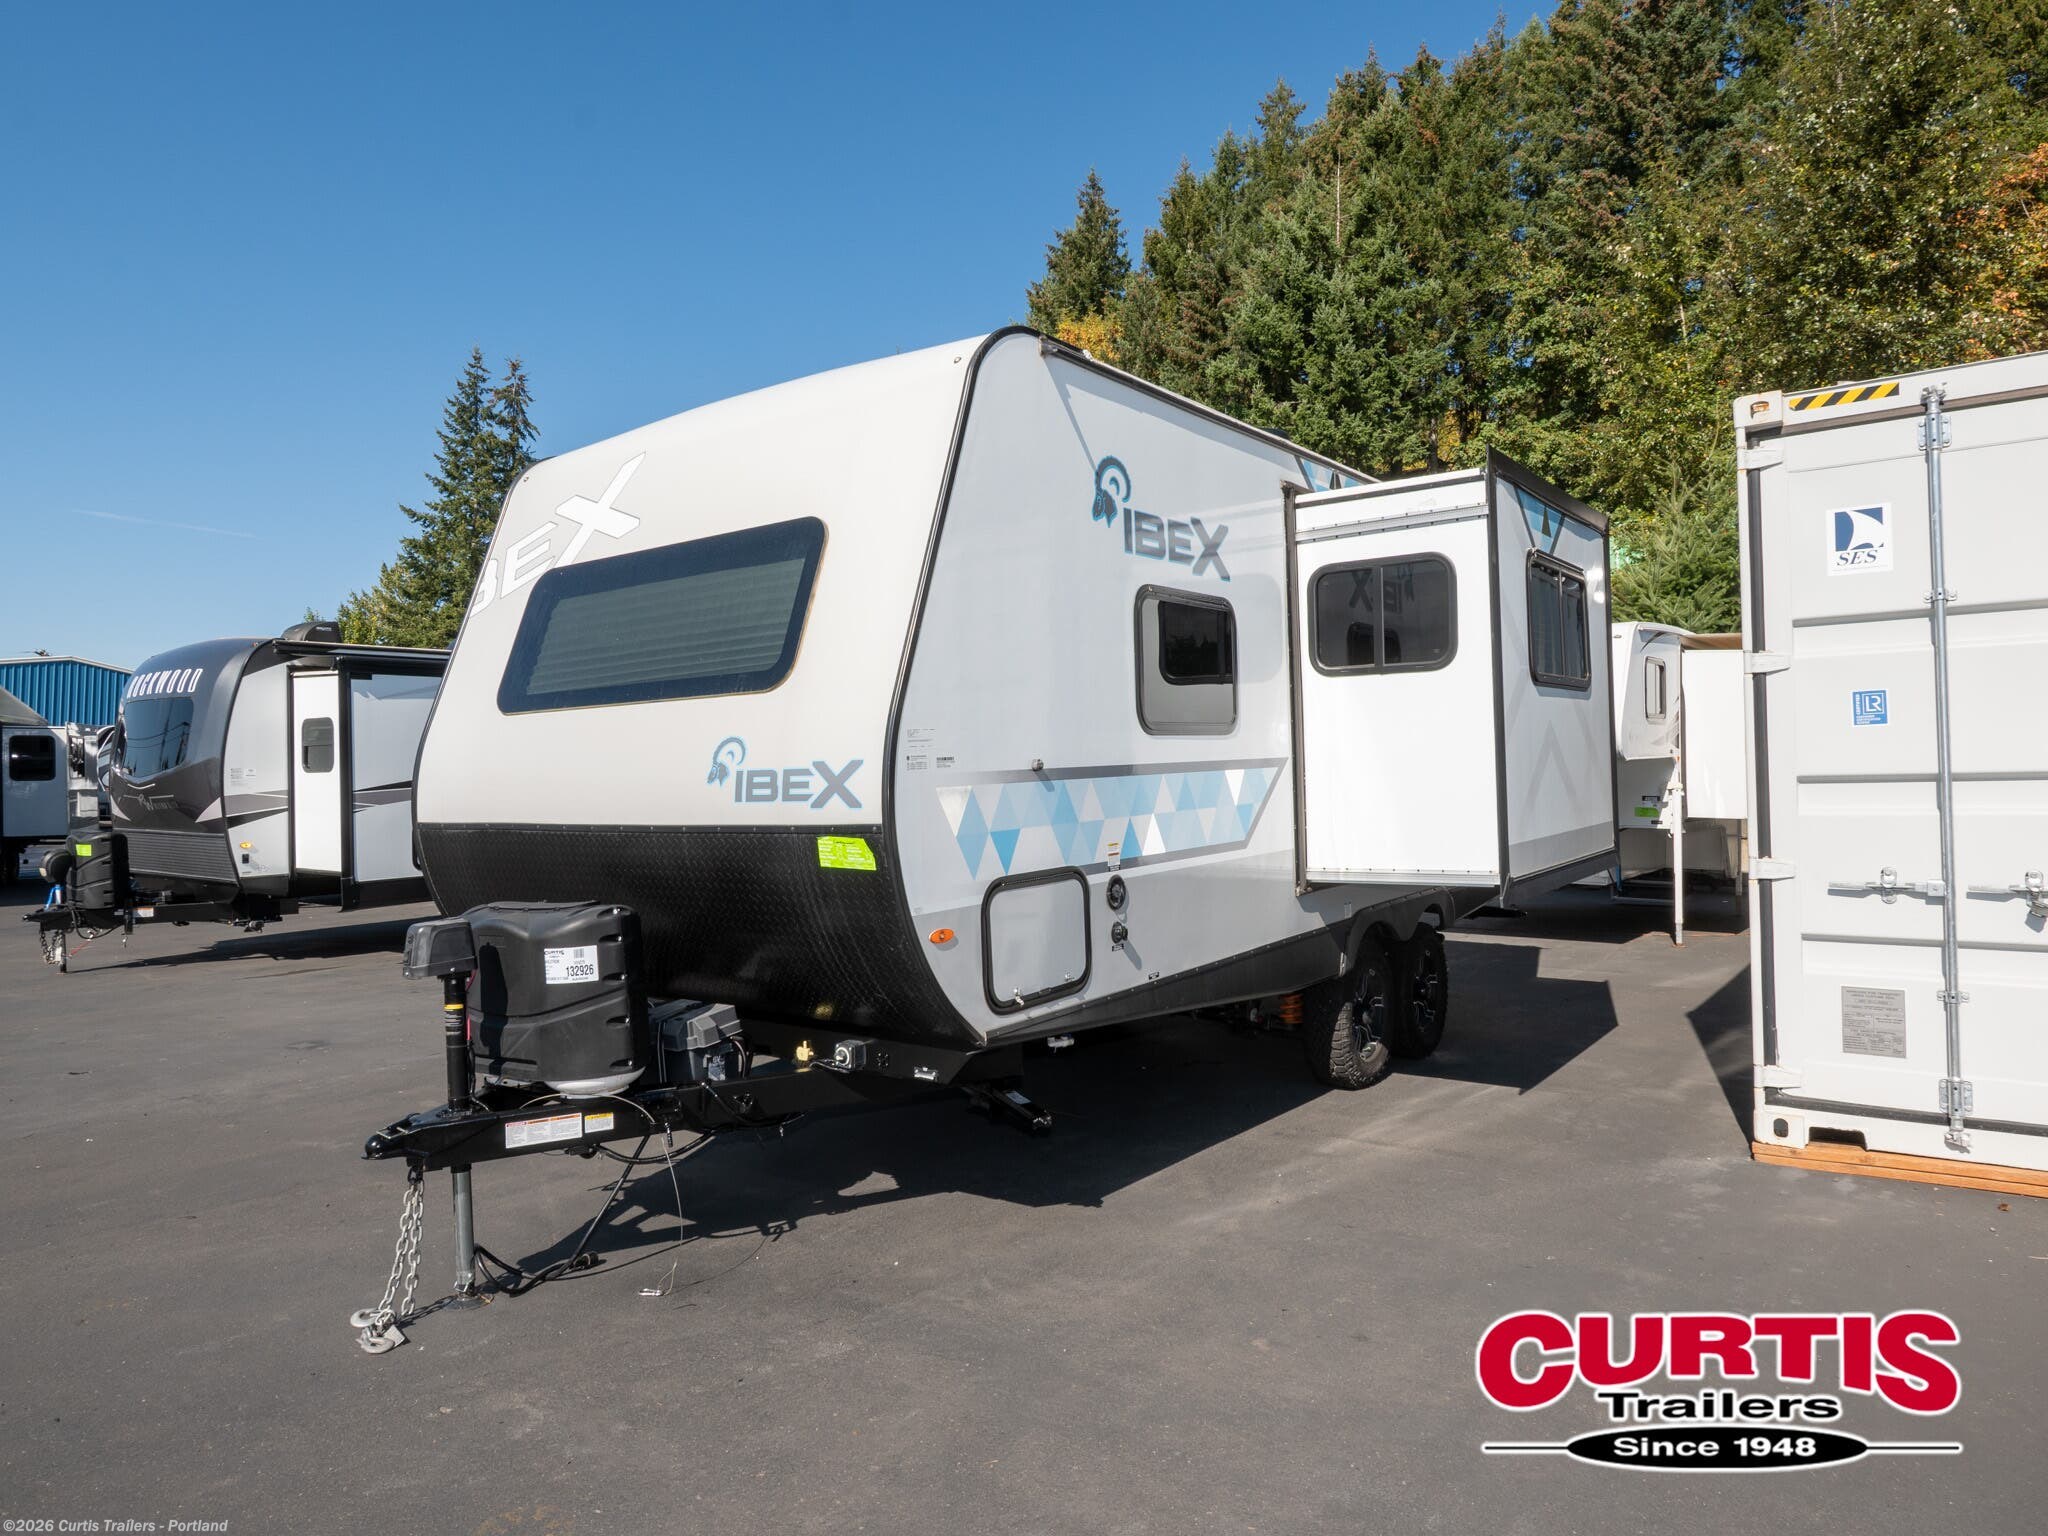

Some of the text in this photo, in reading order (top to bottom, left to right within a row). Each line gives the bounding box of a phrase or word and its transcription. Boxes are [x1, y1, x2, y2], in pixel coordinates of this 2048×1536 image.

[1123, 507, 1231, 582] IBEX
[1836, 549, 1877, 567] SES
[734, 759, 864, 809] IBEX
[566, 964, 594, 977] 132926
